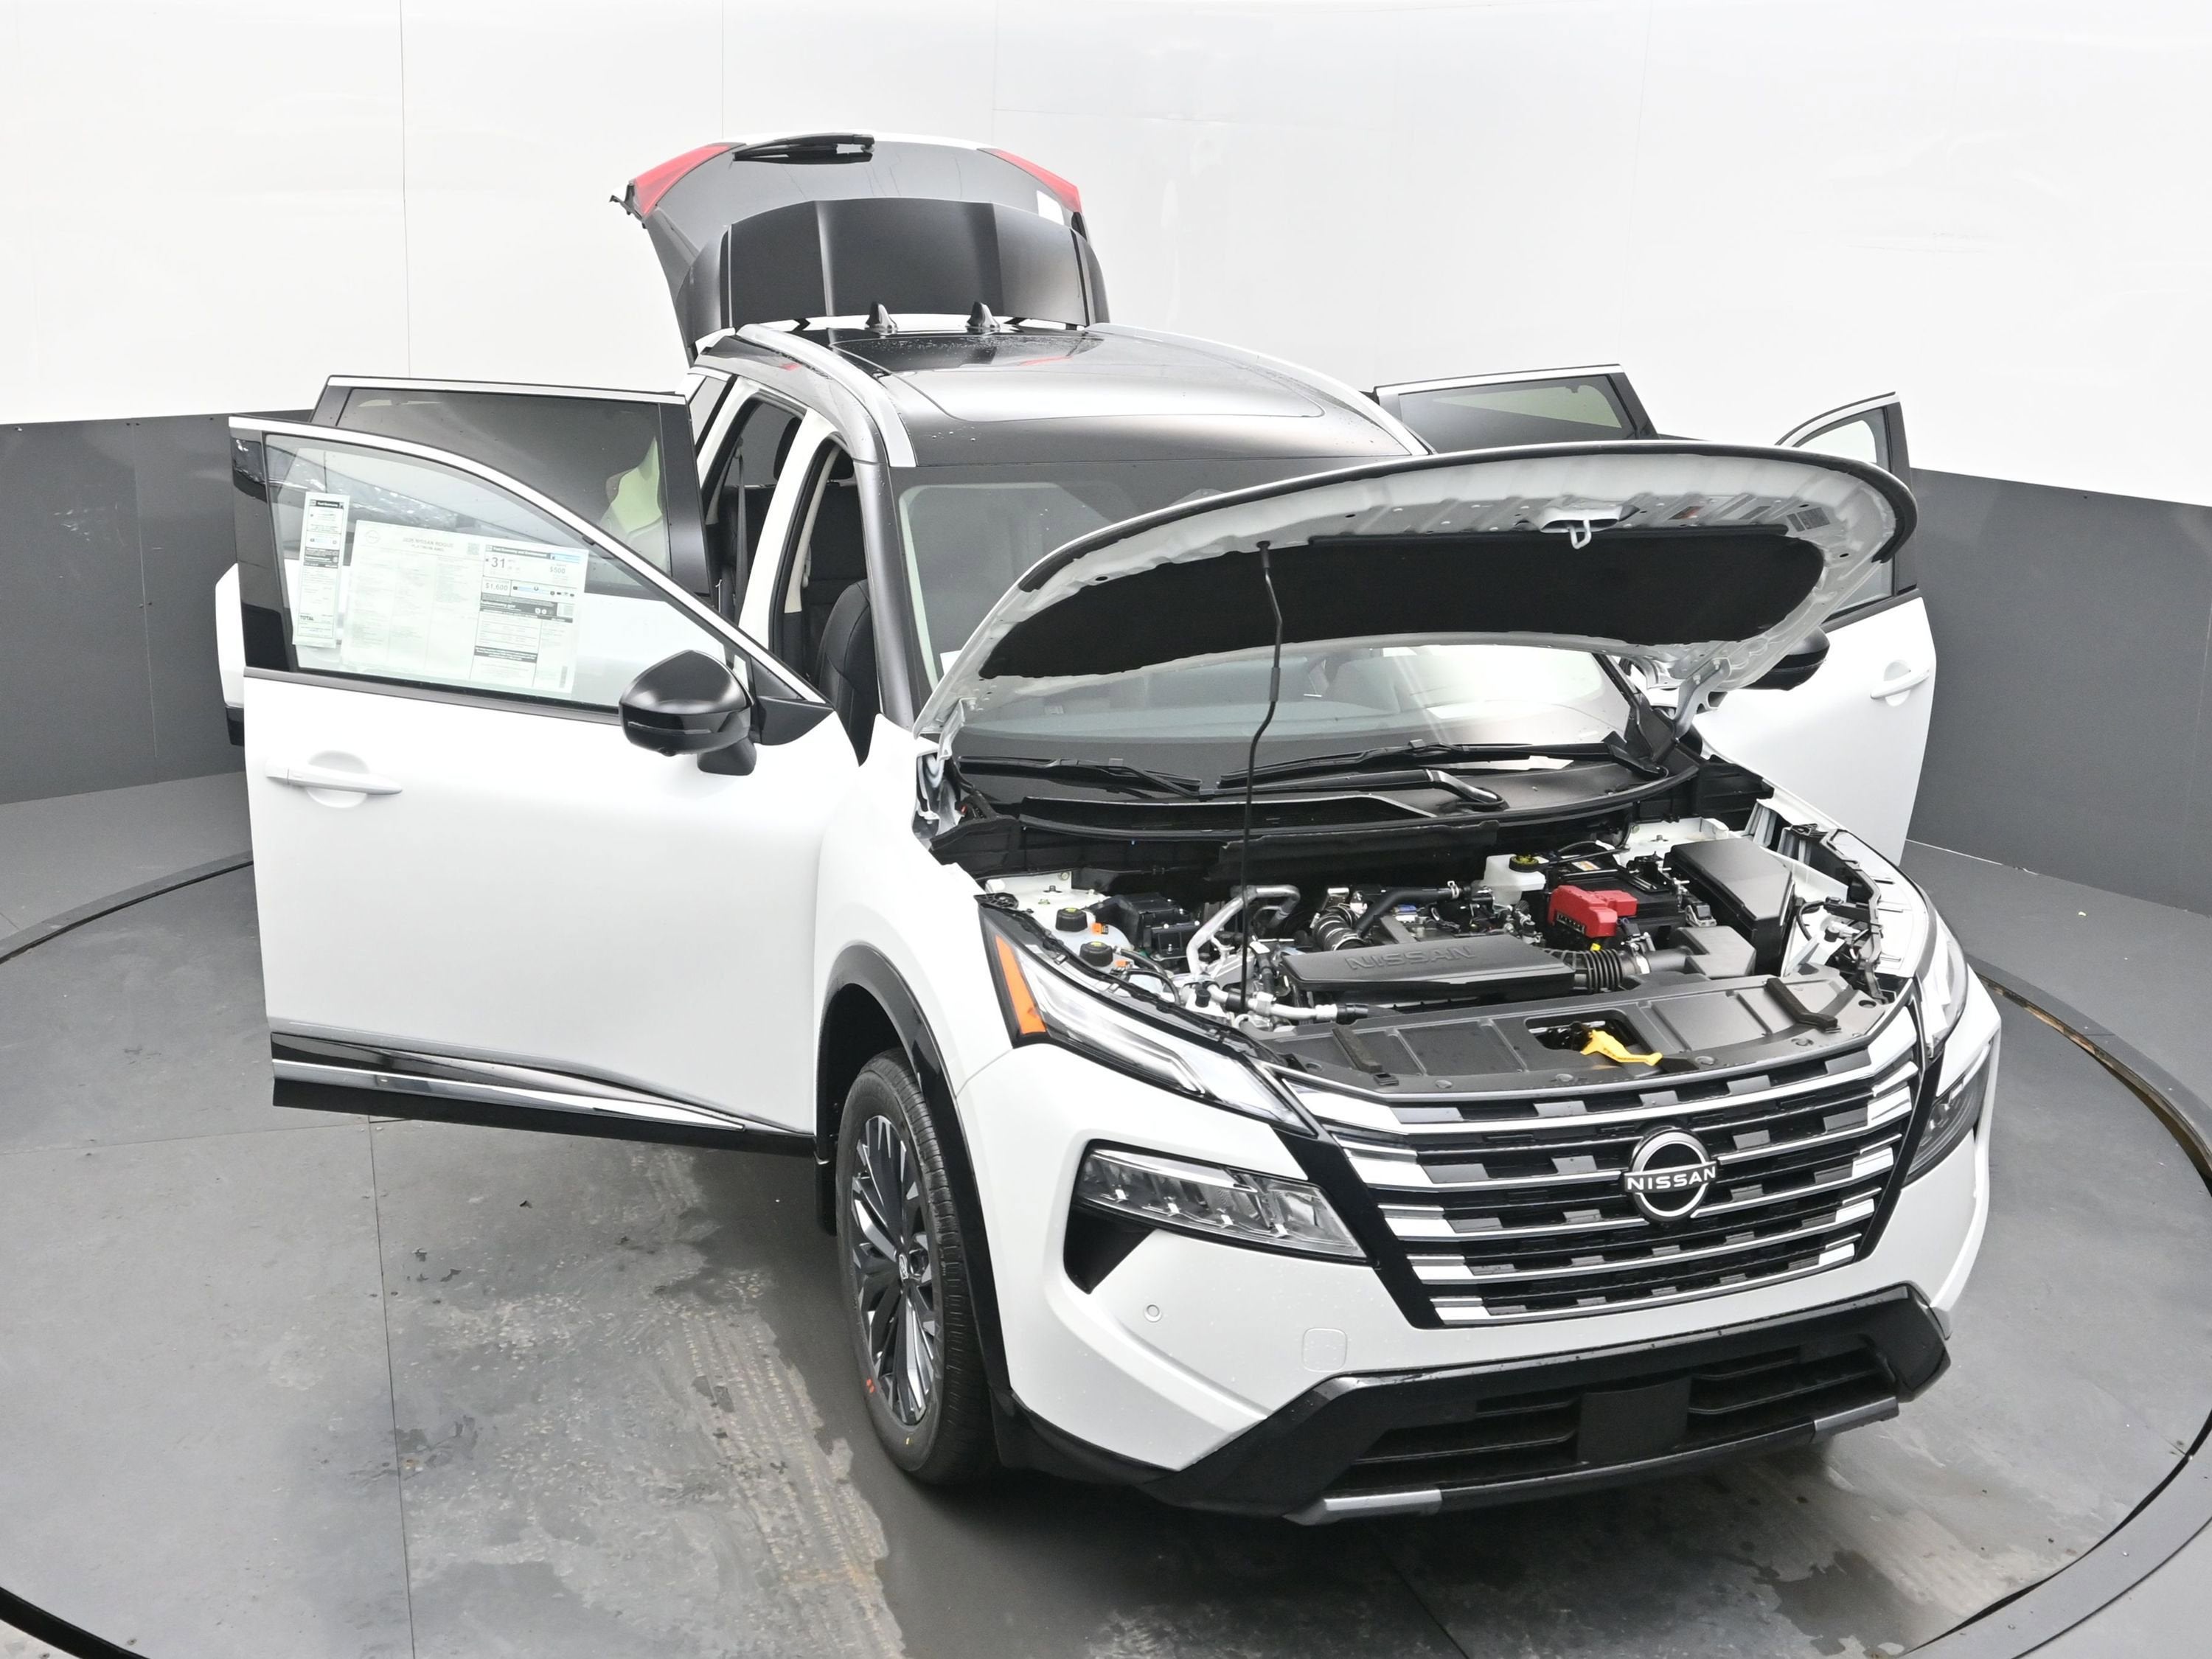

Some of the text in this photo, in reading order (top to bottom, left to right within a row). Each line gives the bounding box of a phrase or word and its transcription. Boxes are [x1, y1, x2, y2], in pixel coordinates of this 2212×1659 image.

[491, 557, 506, 568] 31
[549, 566, 566, 574] $500
[485, 582, 508, 591] $1,600
[1344, 945, 1475, 970] NISSAN
[1627, 1166, 1716, 1191] NISSAN
